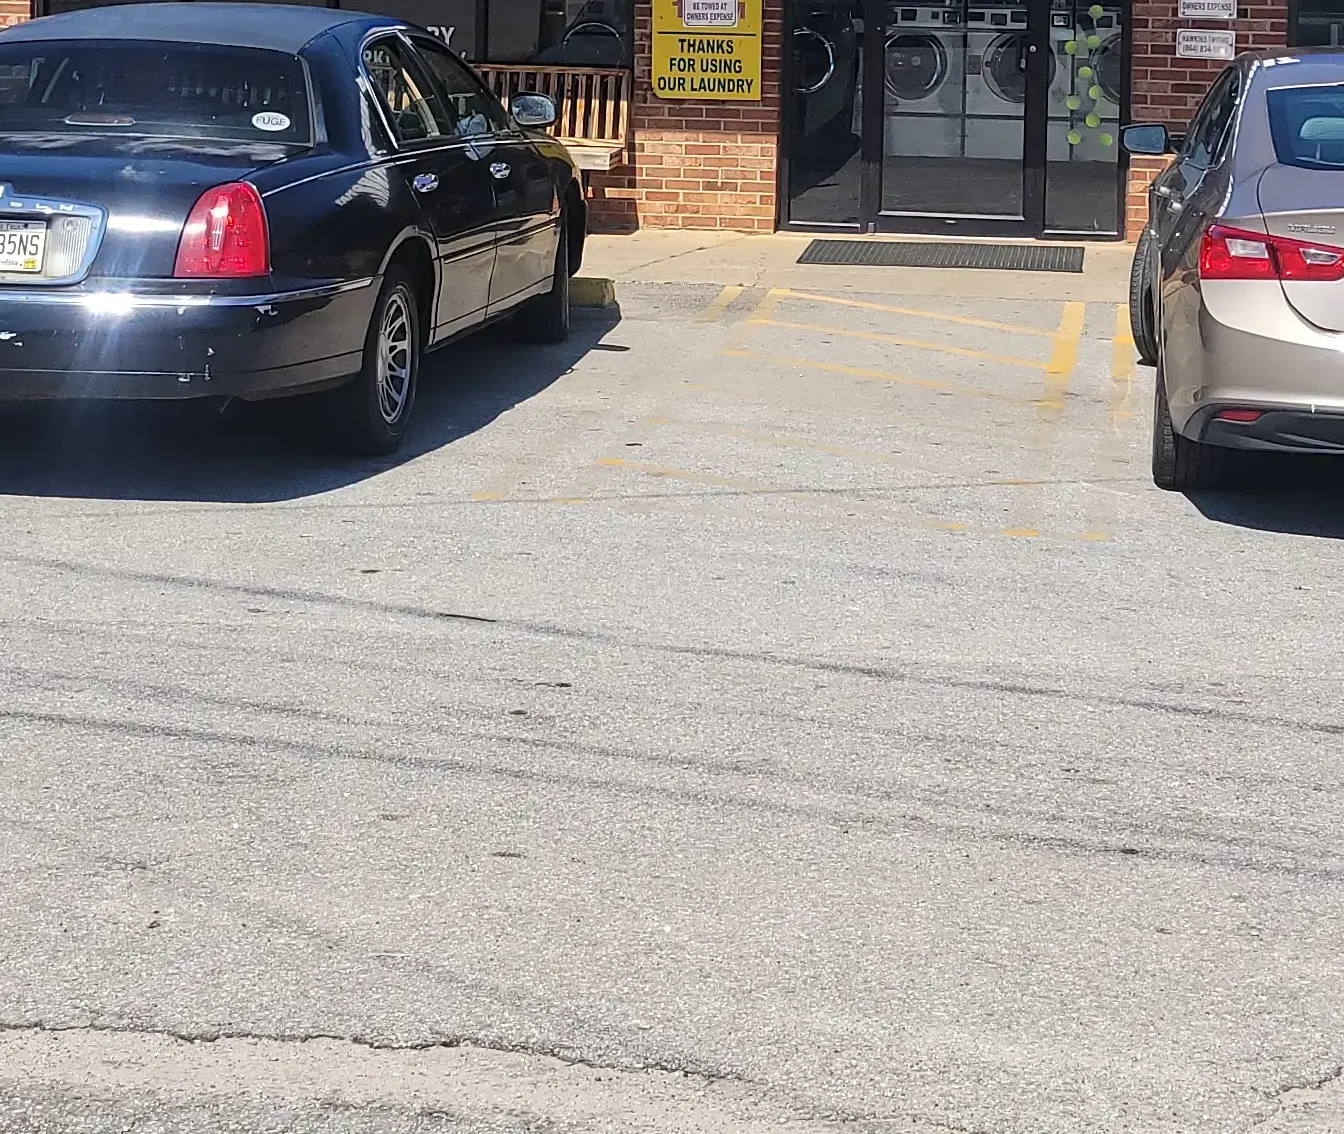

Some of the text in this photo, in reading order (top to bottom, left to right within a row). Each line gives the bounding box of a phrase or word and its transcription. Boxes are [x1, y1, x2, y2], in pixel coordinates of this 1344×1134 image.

[693, 2, 700, 10] BE
[701, 2, 719, 10] TOWED
[1182, 2, 1232, 12] OWNERS EXPENSE
[686, 12, 734, 21] OWNERS EXPENSE
[678, 38, 734, 55] THANKS
[669, 57, 743, 74] FOR USING
[657, 76, 754, 94] OUR LAUNDRY
[256, 115, 287, 126] FUGE
